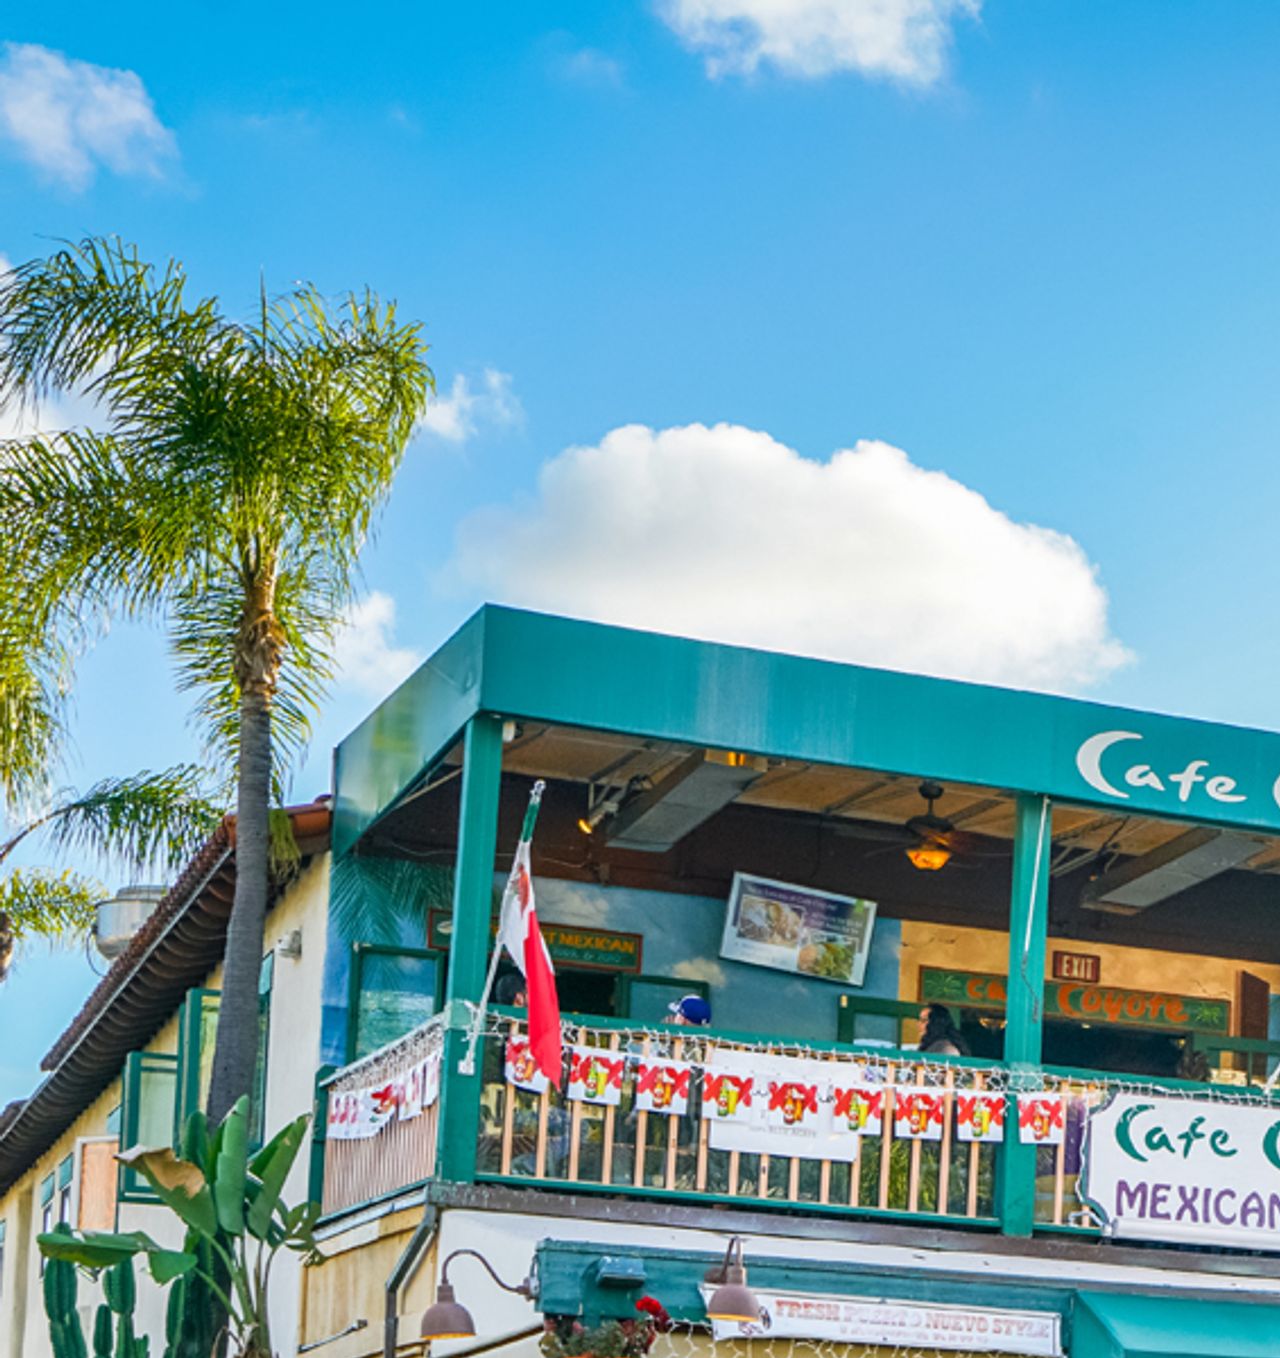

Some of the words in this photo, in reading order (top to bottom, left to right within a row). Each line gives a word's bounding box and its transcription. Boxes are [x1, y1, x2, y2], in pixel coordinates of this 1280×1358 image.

[1075, 730, 1247, 799] Cafe
[559, 933, 635, 954] MEXICAN
[1061, 955, 1095, 979] EXIT
[1056, 982, 1189, 1022] Coyote
[1114, 1104, 1238, 1162] Cafe
[775, 1299, 841, 1322] FRESH
[926, 1311, 989, 1334] NUEVO
[992, 1318, 1050, 1339] STYLE
